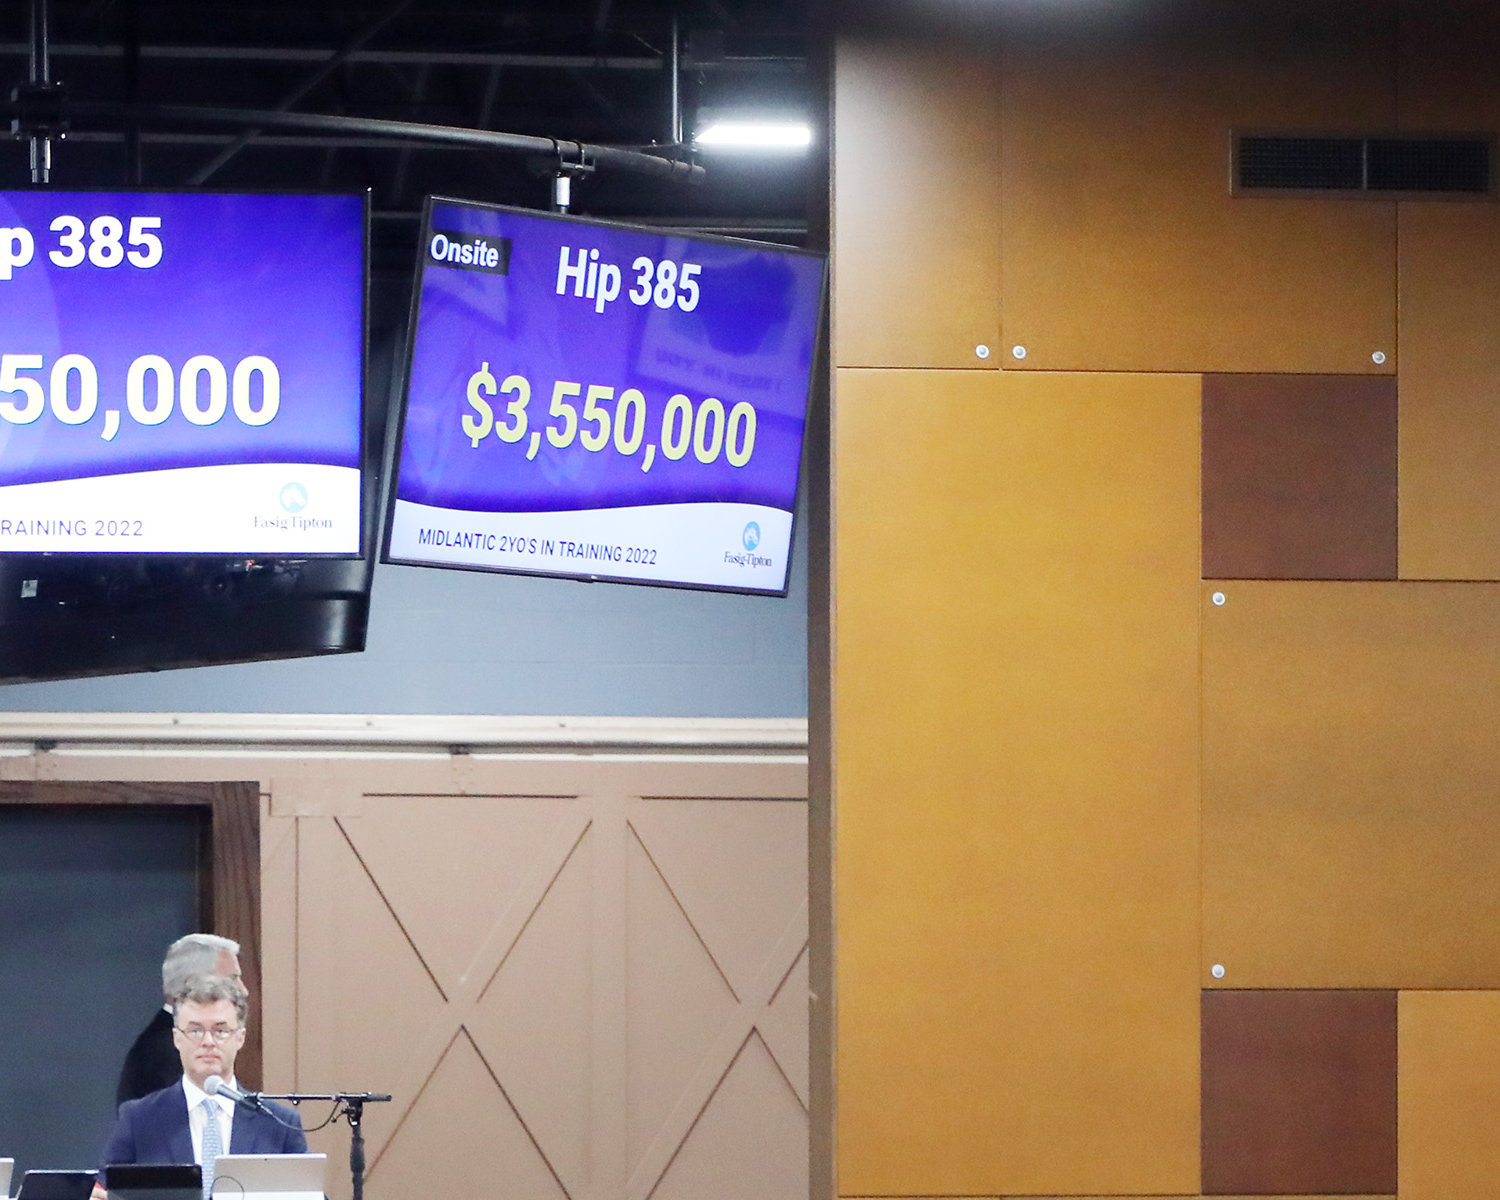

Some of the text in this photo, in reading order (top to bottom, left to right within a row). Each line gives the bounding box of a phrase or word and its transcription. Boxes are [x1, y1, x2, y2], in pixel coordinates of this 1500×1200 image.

[48, 215, 163, 270] 385
[430, 234, 499, 268] Onsite
[555, 246, 702, 314] Hip 385
[461, 361, 758, 473] $3,550,000
[94, 518, 144, 537] 2022
[418, 527, 658, 566] MIDLANTIC 2YO'S IN TRAINING 2022
[723, 550, 773, 568] Fasig-Tipton
